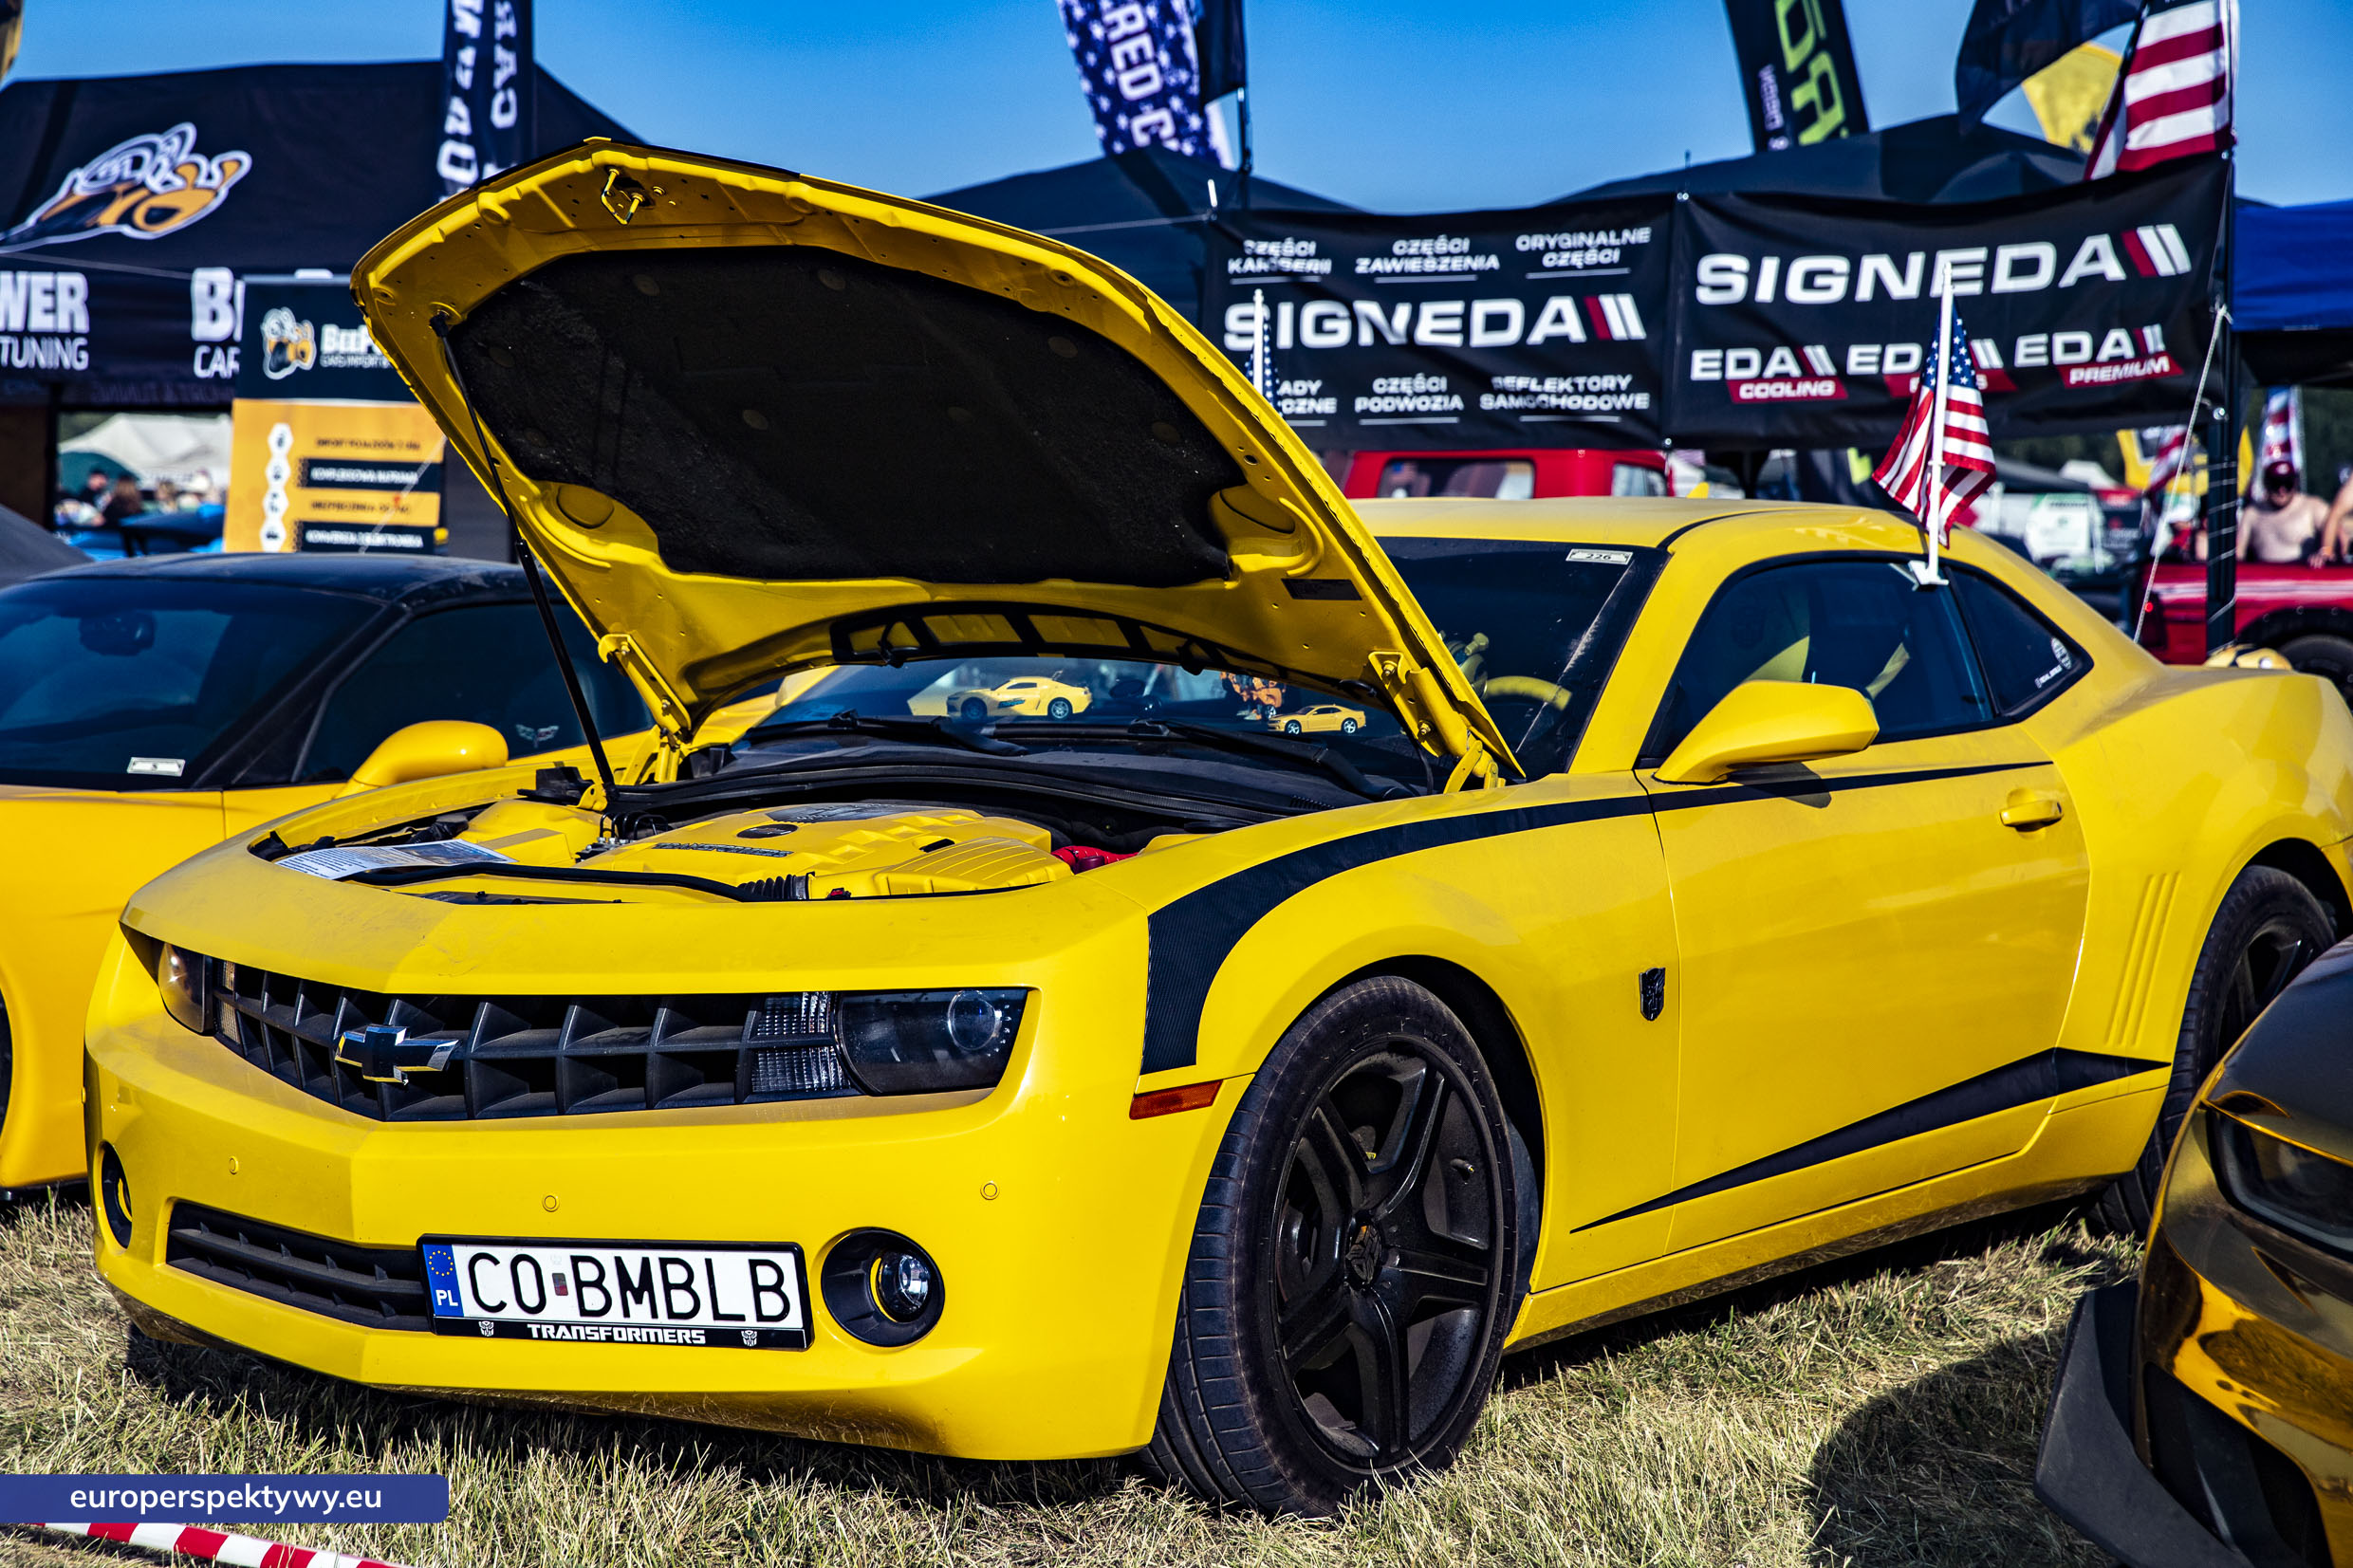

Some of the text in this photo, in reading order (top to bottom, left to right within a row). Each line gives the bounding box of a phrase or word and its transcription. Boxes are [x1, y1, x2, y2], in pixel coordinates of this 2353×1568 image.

[1392, 234, 1470, 257] CZĘŚCI
[1515, 227, 1652, 252] ORYGINALNE
[1355, 254, 1500, 274] ZAWIESZENIA
[1696, 233, 2127, 305] SIGNEDA
[191, 267, 246, 342] B
[1223, 295, 1587, 352] SIGNEDA
[0, 336, 90, 371] TUNING
[1846, 342, 1923, 376] ED
[2013, 327, 2136, 368] EDA
[1690, 345, 1803, 381] EDA
[2068, 355, 2171, 385] PREMIUM
[1278, 379, 1323, 397] ADY
[1372, 372, 1448, 397] CZĘŚCI
[1491, 374, 1633, 393] REFLEKTORY
[1738, 379, 1836, 400] COOLING
[1281, 397, 1338, 415] CZNE
[1355, 395, 1465, 414] PODWOZIA
[1479, 393, 1651, 411] SAMOCHODOWE
[435, 1289, 458, 1307] PL
[569, 1254, 791, 1323] BMBLB
[527, 1322, 706, 1344] TRANSFORMERS
